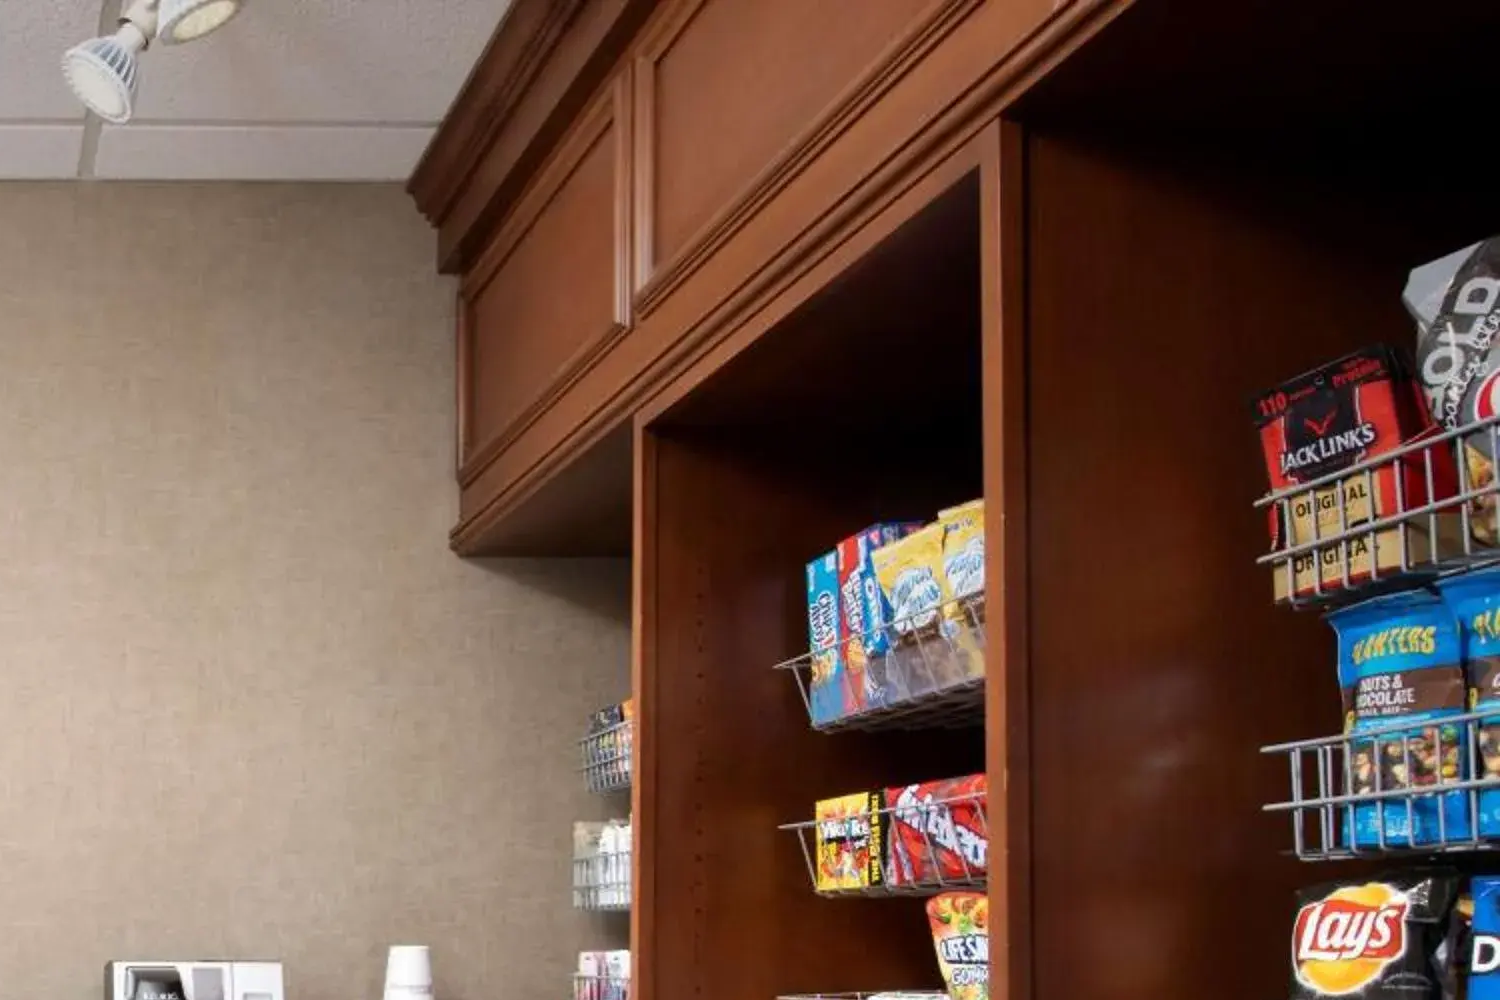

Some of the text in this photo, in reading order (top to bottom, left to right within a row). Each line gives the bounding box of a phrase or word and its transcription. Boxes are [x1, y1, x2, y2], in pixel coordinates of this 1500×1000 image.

[1280, 423, 1376, 476] JACK LINK'S
[1298, 904, 1401, 960] Lay's
